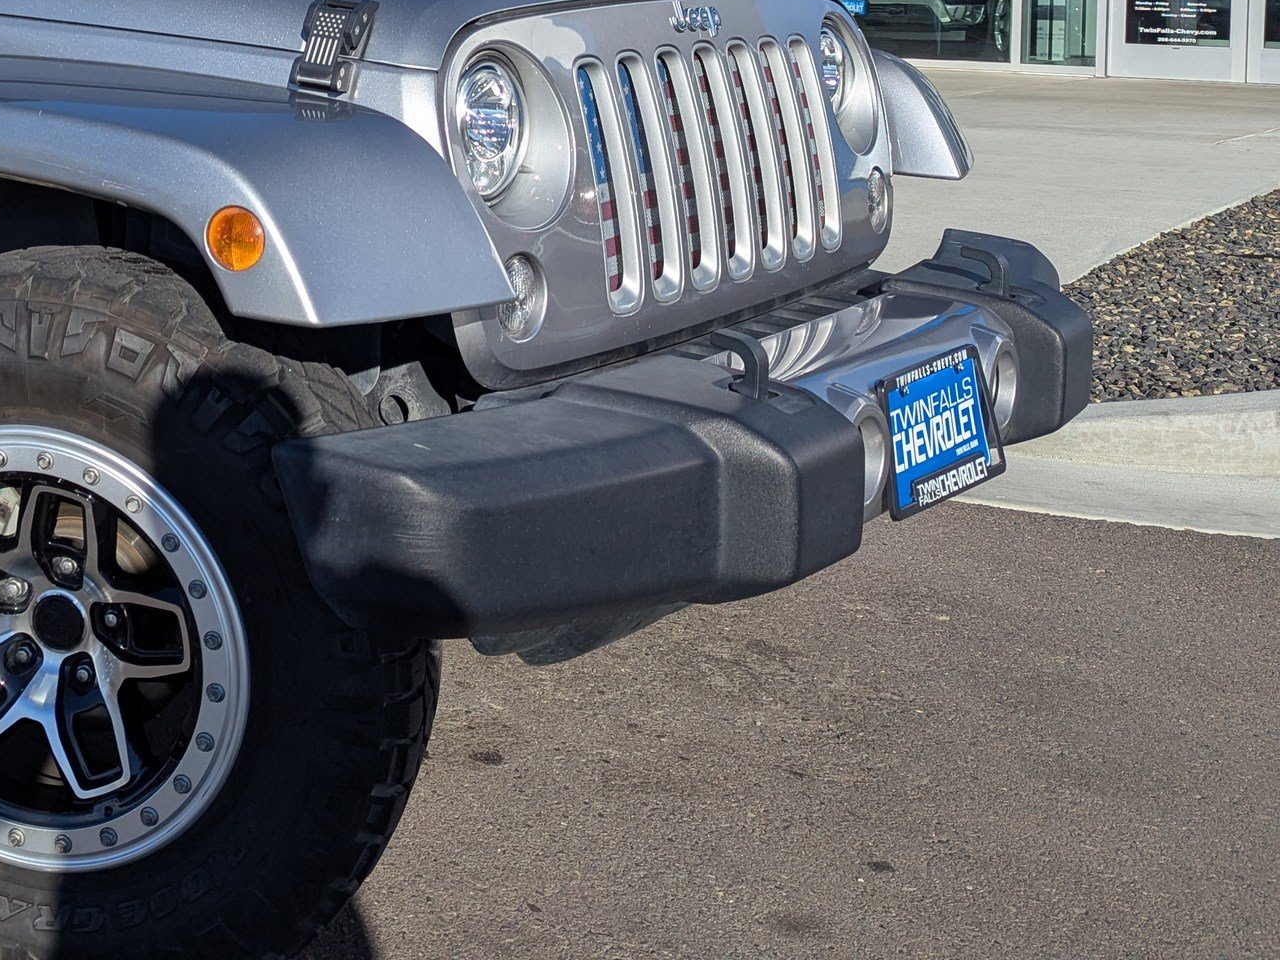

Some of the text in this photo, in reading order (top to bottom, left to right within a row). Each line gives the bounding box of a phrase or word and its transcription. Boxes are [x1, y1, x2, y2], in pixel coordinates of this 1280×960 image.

[669, 0, 722, 37] Jeep
[1138, 27, 1217, 36] TwinFalls-Chevy.com
[895, 348, 968, 388] TWINFALLS-CHEVY.COM
[890, 376, 974, 434] TWINFALLS
[892, 397, 977, 474] CHEVROLET
[916, 456, 988, 498] TWIN CHEVROLET
[918, 488, 942, 507] FALLS
